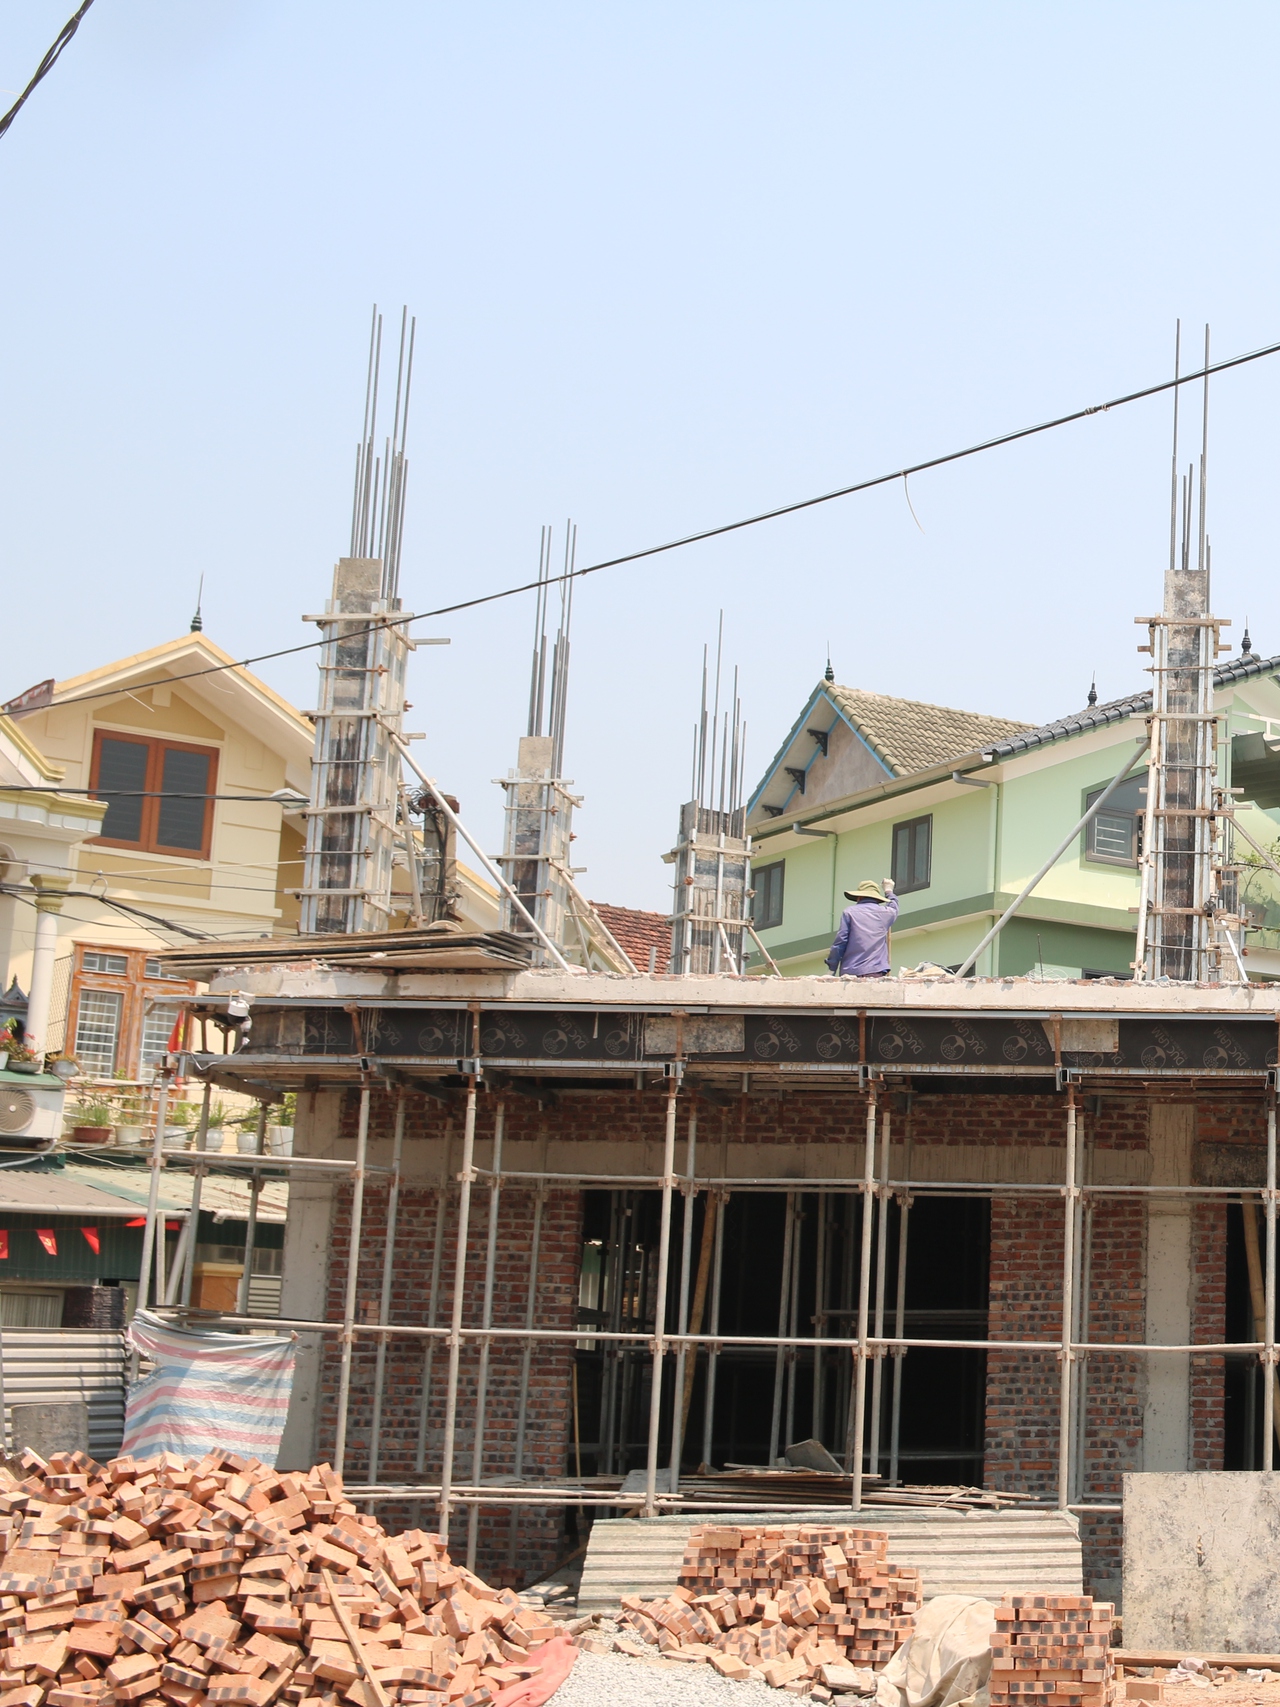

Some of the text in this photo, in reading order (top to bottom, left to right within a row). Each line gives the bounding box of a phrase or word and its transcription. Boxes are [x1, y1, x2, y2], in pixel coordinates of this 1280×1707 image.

[490, 1011, 510, 1031] LAM
[552, 1012, 572, 1032] LAM
[764, 1015, 784, 1035] LAM
[826, 1015, 846, 1035] LAM
[888, 1017, 908, 1037] LAM
[950, 1017, 970, 1037] LAM
[1012, 1018, 1032, 1038] LAM
[380, 1025, 400, 1046] DUC
[504, 1026, 525, 1049] DUC
[566, 1028, 587, 1050] DUC
[778, 1031, 799, 1053] DUC
[840, 1031, 861, 1053] DUC
[902, 1033, 923, 1055] DUC
[964, 1033, 985, 1055] DUC
[1027, 1034, 1047, 1056] DUC
[1150, 1025, 1170, 1048] LAM
[1212, 1026, 1232, 1049] LAM
[1165, 1044, 1185, 1066] DUC
[1227, 1045, 1247, 1067] DUC
